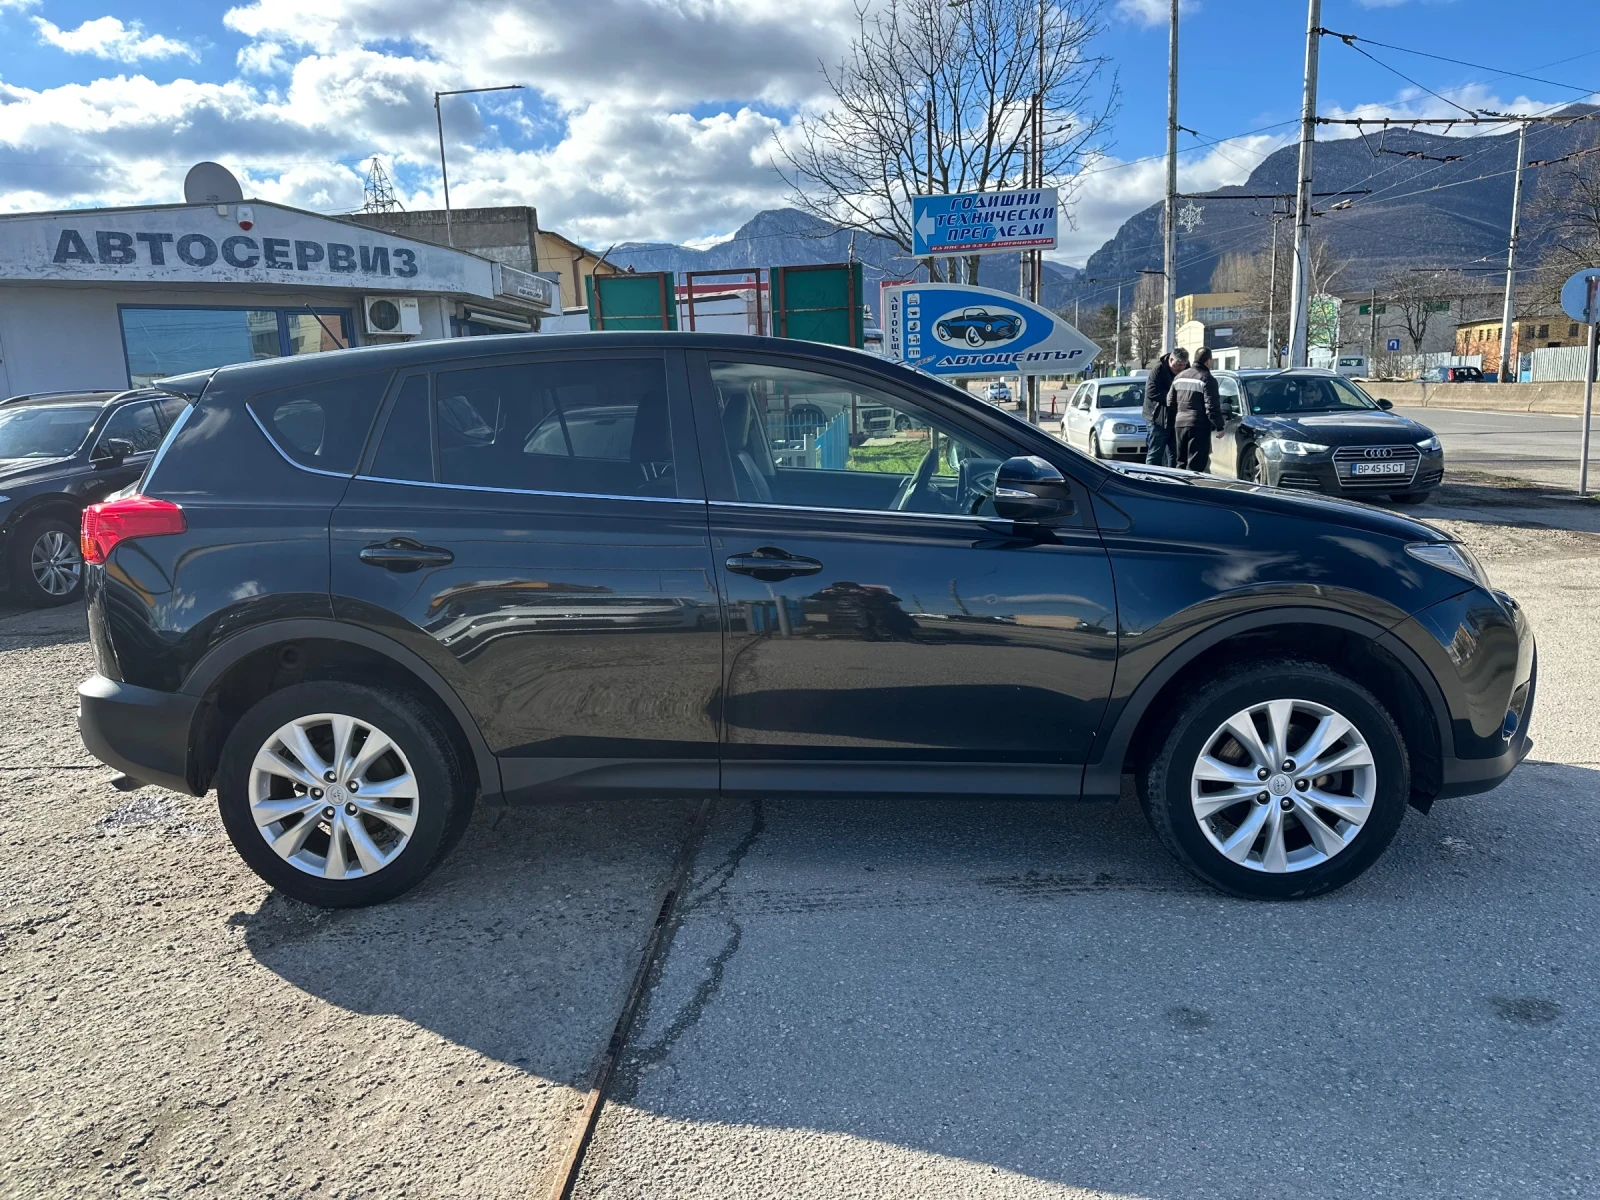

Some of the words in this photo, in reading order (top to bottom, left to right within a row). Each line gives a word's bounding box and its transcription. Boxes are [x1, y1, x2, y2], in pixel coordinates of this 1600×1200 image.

[950, 192, 1041, 211] ГОДИШНИ
[937, 207, 1054, 227] ТЕХНИЧЕСКИ
[947, 223, 1045, 241] ПРЕГЛЕДИ
[53, 228, 419, 278] АВТОСЕРВИЗ
[890, 296, 900, 358] АВТОКЪЩА
[936, 349, 1083, 367] АВТОЦЕНТЪР
[1358, 464, 1370, 474] BP
[1371, 463, 1392, 473] 4515
[1392, 463, 1404, 472] CT
